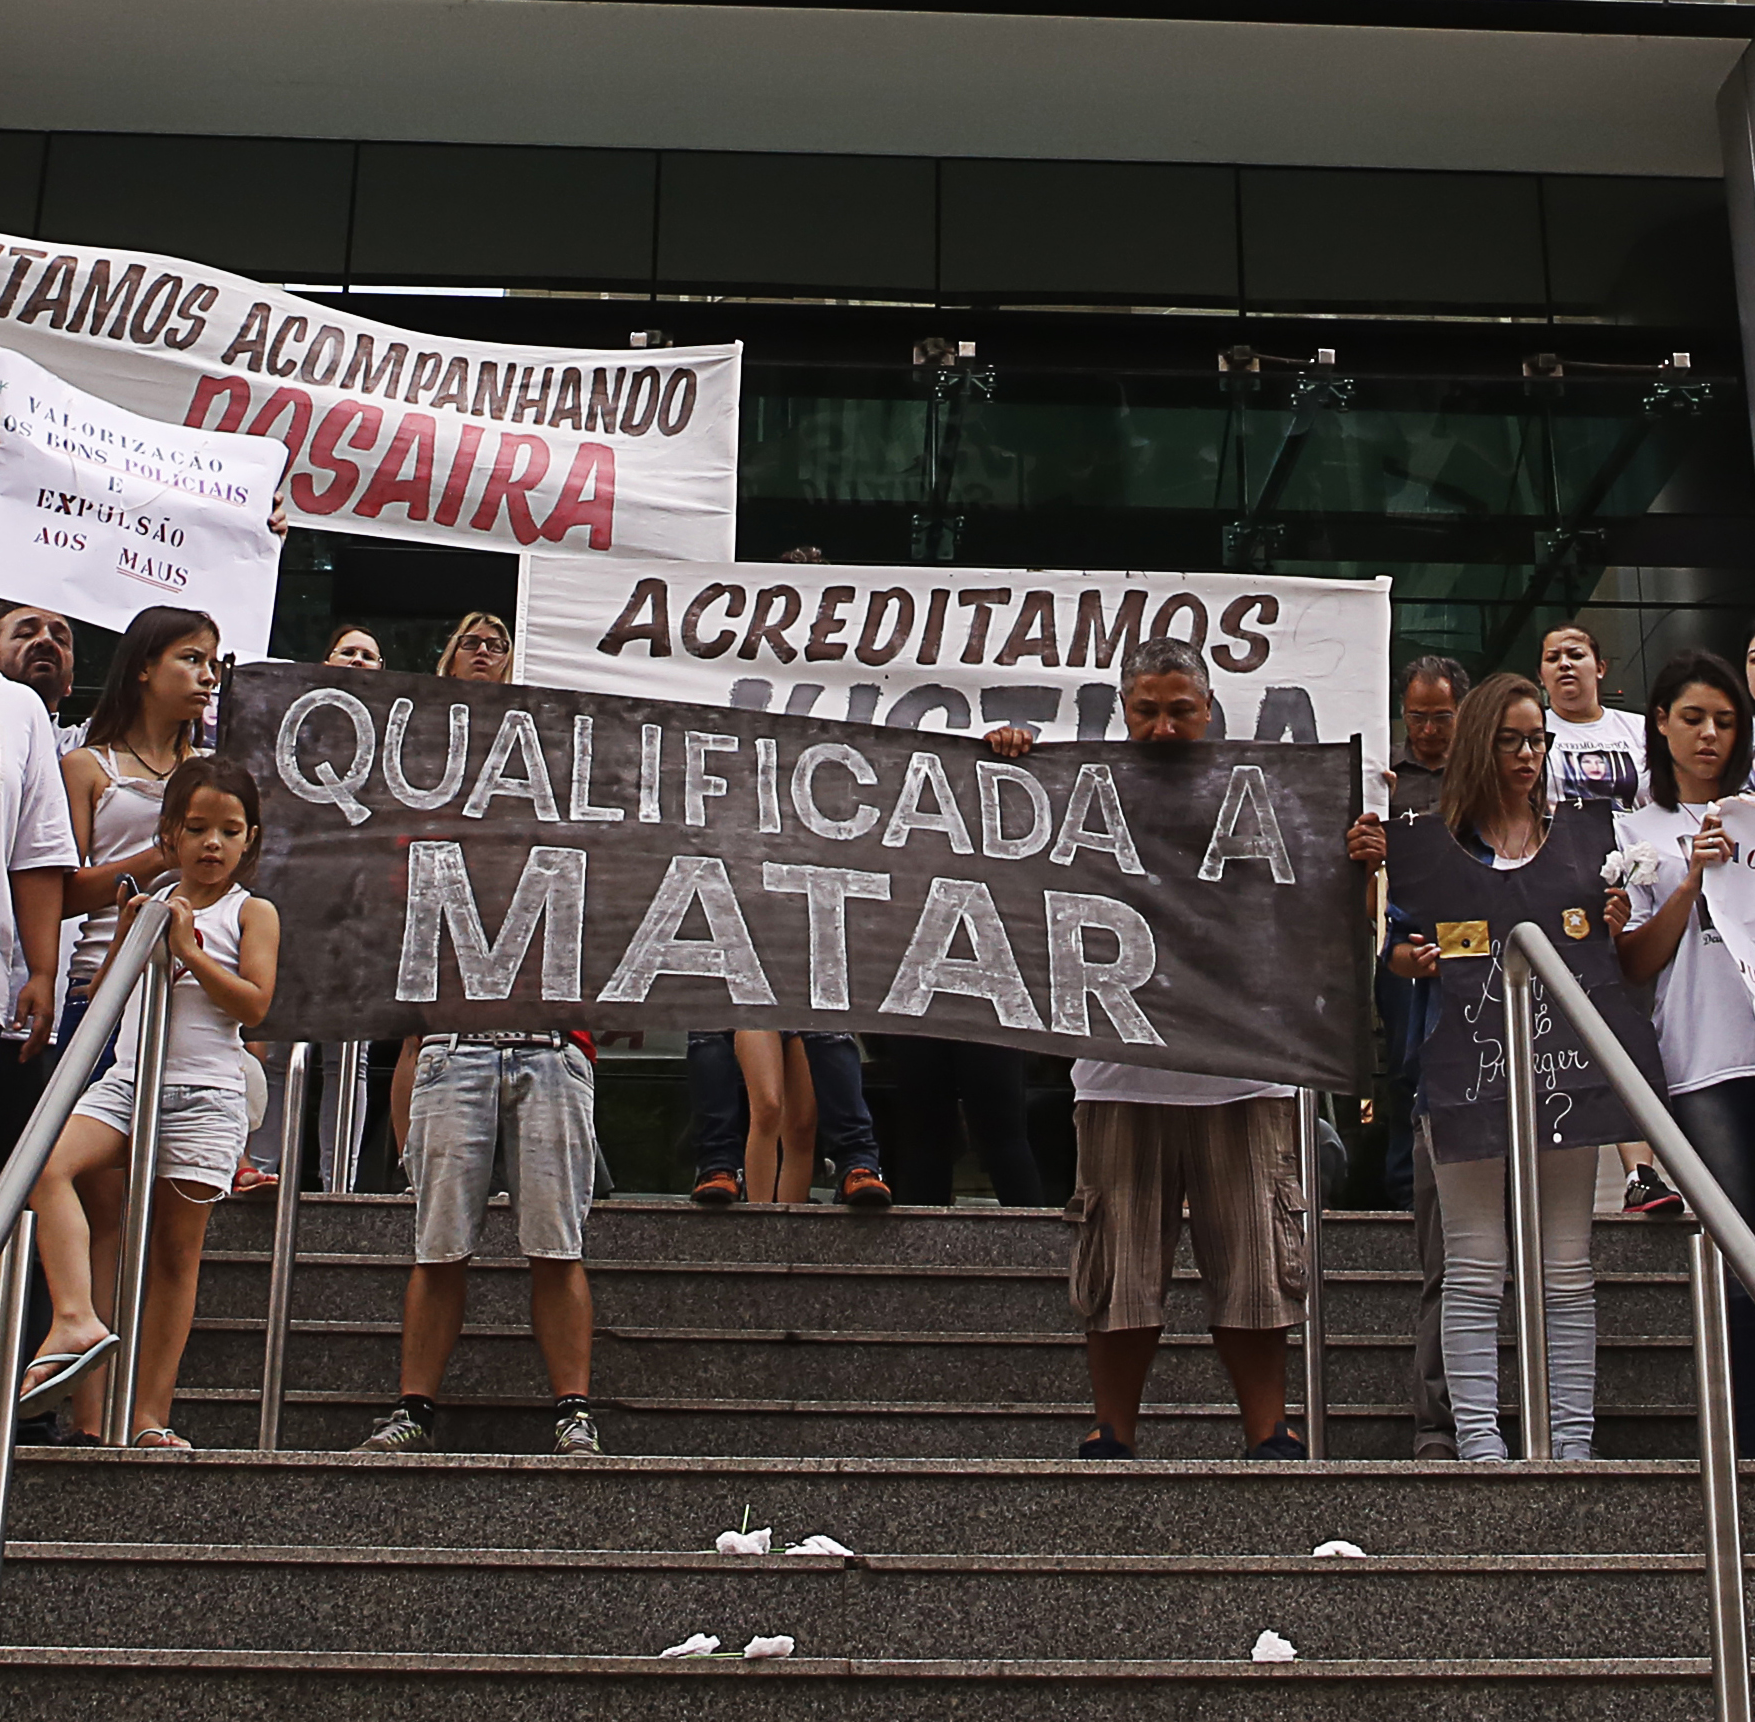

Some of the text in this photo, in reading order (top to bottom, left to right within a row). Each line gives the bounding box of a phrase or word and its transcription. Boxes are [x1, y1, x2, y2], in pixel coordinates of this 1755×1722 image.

[221, 303, 697, 436] ACOMPANHANDO
[47, 432, 108, 465] BONS
[109, 475, 123, 493] E
[36, 488, 184, 548] EXPULSÃO
[34, 527, 188, 586] AOS MAUS
[596, 576, 1279, 674] ACREDITAMOS
[274, 687, 1145, 876] QUALIFICADA
[1198, 764, 1296, 885] A
[395, 840, 1168, 1047] MATAR
[1466, 1031, 1589, 1102] Preger
[1545, 1092, 1573, 1144] ?
